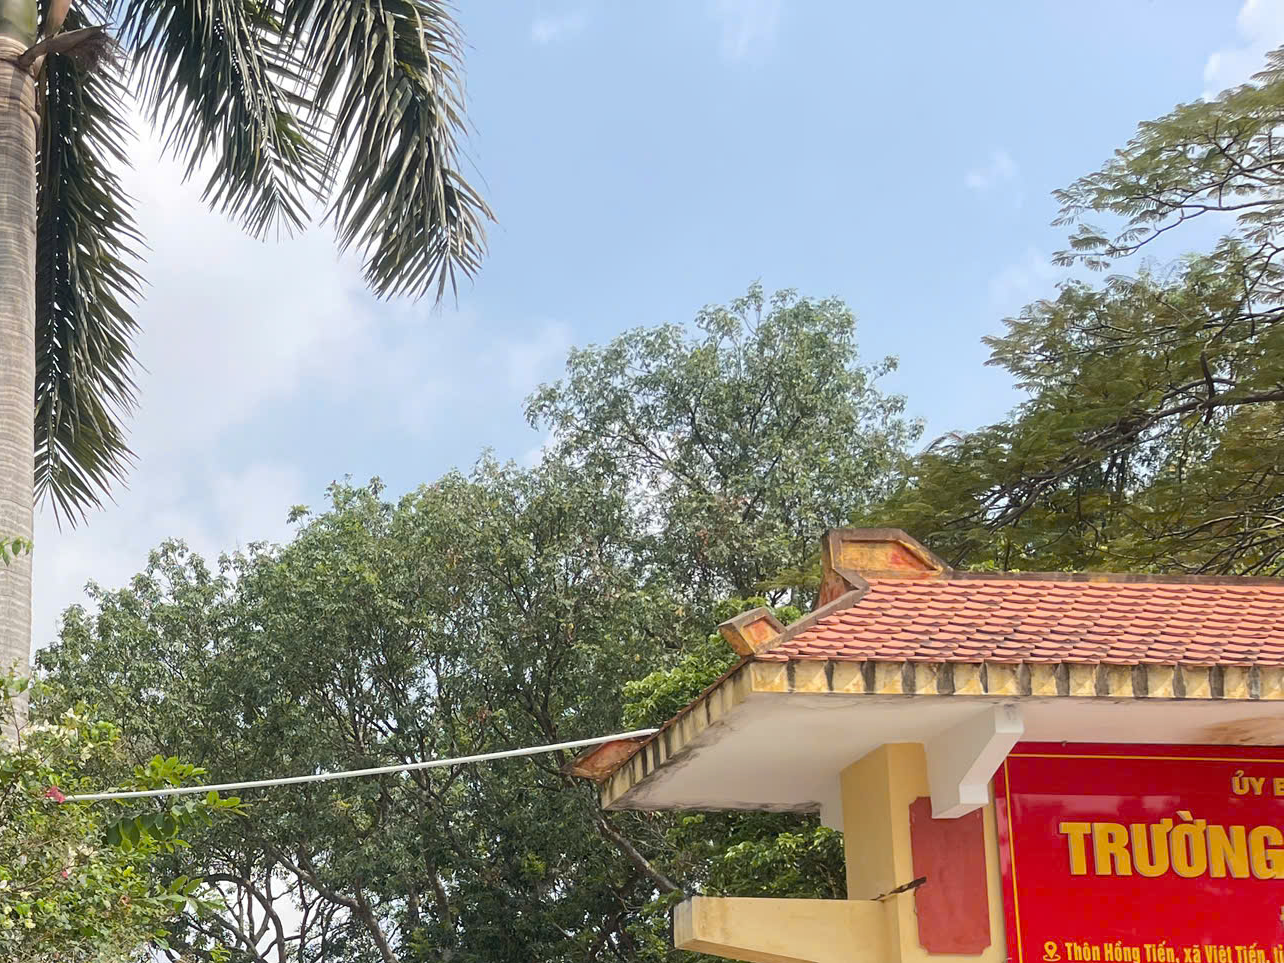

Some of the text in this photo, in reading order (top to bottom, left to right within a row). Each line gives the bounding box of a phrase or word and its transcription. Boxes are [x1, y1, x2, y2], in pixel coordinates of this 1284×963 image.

[1231, 769, 1265, 796] ỦY
[1059, 810, 1284, 880] TRƯỜNG
[1064, 941, 1101, 962] Thôn
[1184, 944, 1201, 963] xã
